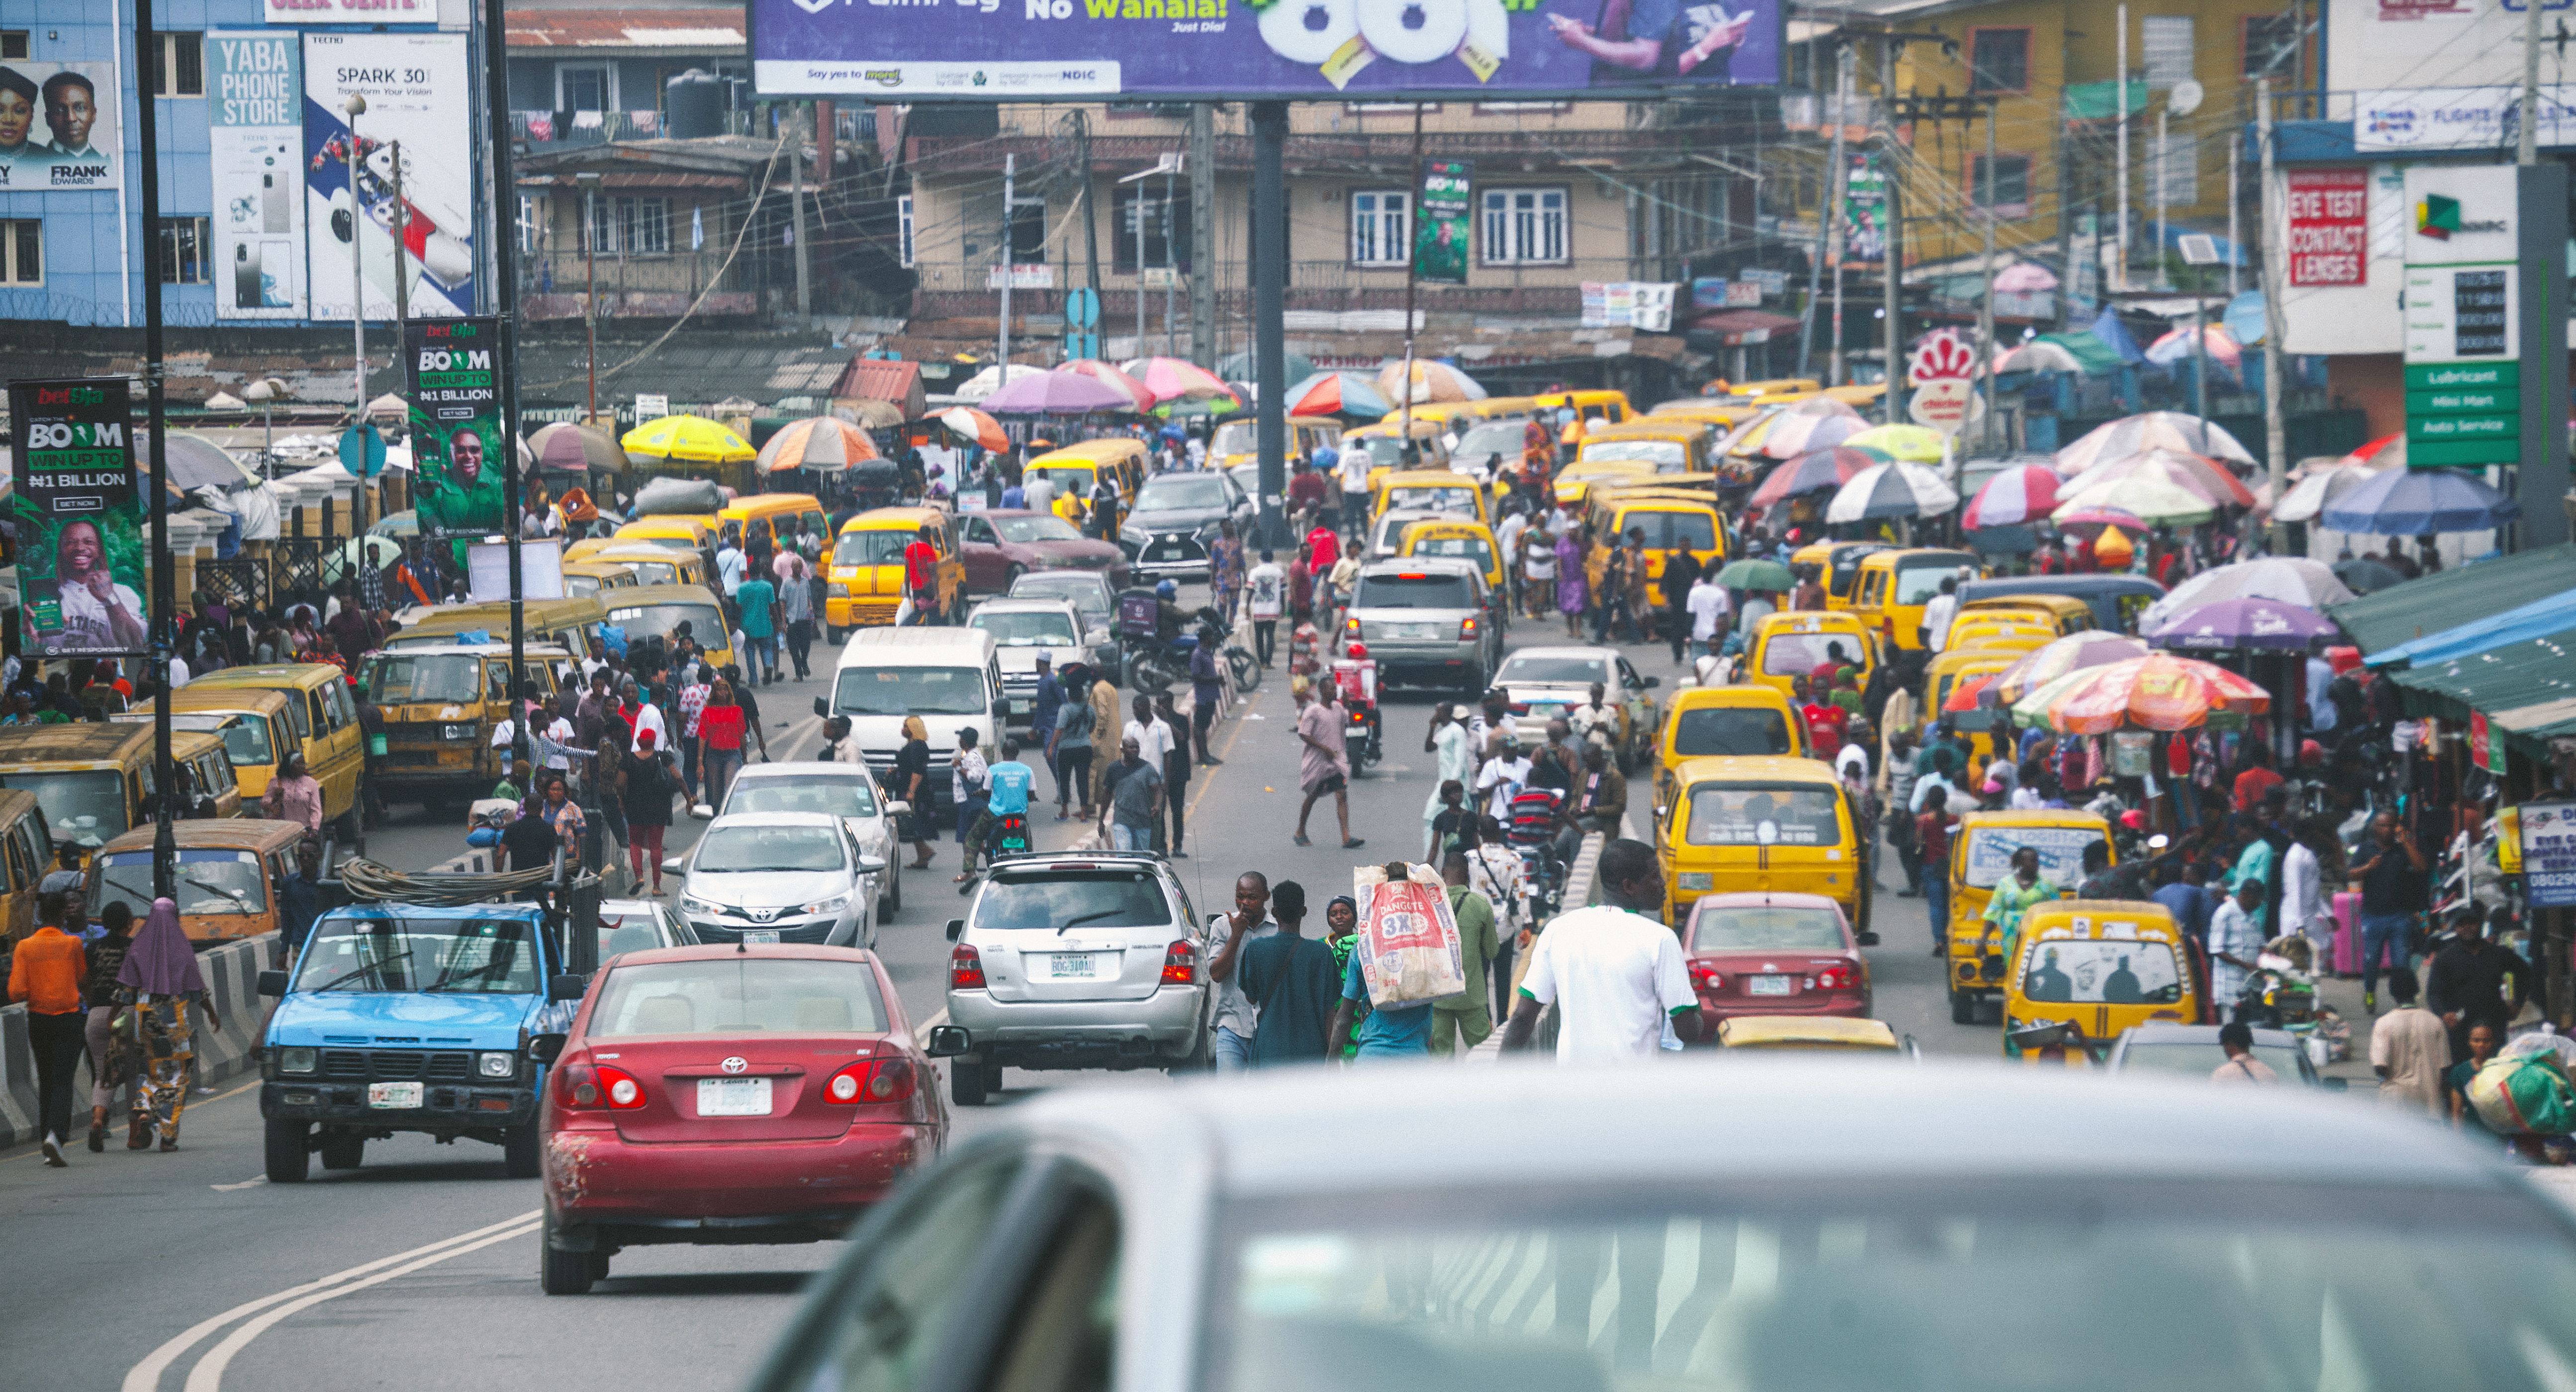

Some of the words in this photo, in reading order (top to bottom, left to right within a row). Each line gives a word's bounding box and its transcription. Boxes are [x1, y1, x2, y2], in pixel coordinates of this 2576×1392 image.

[1025, 0, 1073, 19] No
[1171, 21, 1197, 33] Just
[1199, 22, 1226, 32] Dial
[220, 40, 288, 72] YABA
[337, 68, 395, 83] SPARK
[404, 69, 425, 84] 30
[808, 69, 827, 80] Say
[829, 71, 846, 80] yes
[851, 70, 861, 79] to
[1062, 71, 1096, 80] NDIC
[221, 74, 290, 99] PHONE
[224, 99, 289, 124] STORE
[51, 165, 107, 177] FRANK
[2290, 192, 2322, 218] EYE
[2325, 192, 2364, 217] TEST
[2292, 226, 2365, 253] CONTACT
[2295, 256, 2359, 282] LENSES
[421, 374, 446, 385] WIN
[449, 373, 466, 384] UP
[470, 372, 490, 384] TO
[2428, 370, 2498, 385] Lubricant
[38, 386, 103, 407] bet9ja
[441, 389, 492, 401] BILLION
[2431, 395, 2461, 407] Mini
[2463, 394, 2493, 407] Mart
[2423, 420, 2455, 434] Auto
[2458, 418, 2504, 432] Service
[31, 453, 67, 469] WIN
[71, 451, 94, 467] UP
[97, 450, 121, 465] TO
[58, 473, 126, 487] BILLION
[1359, 922, 1368, 936] 3X
[1384, 915, 1412, 936] 3X
[1446, 928, 1456, 943] 3X
